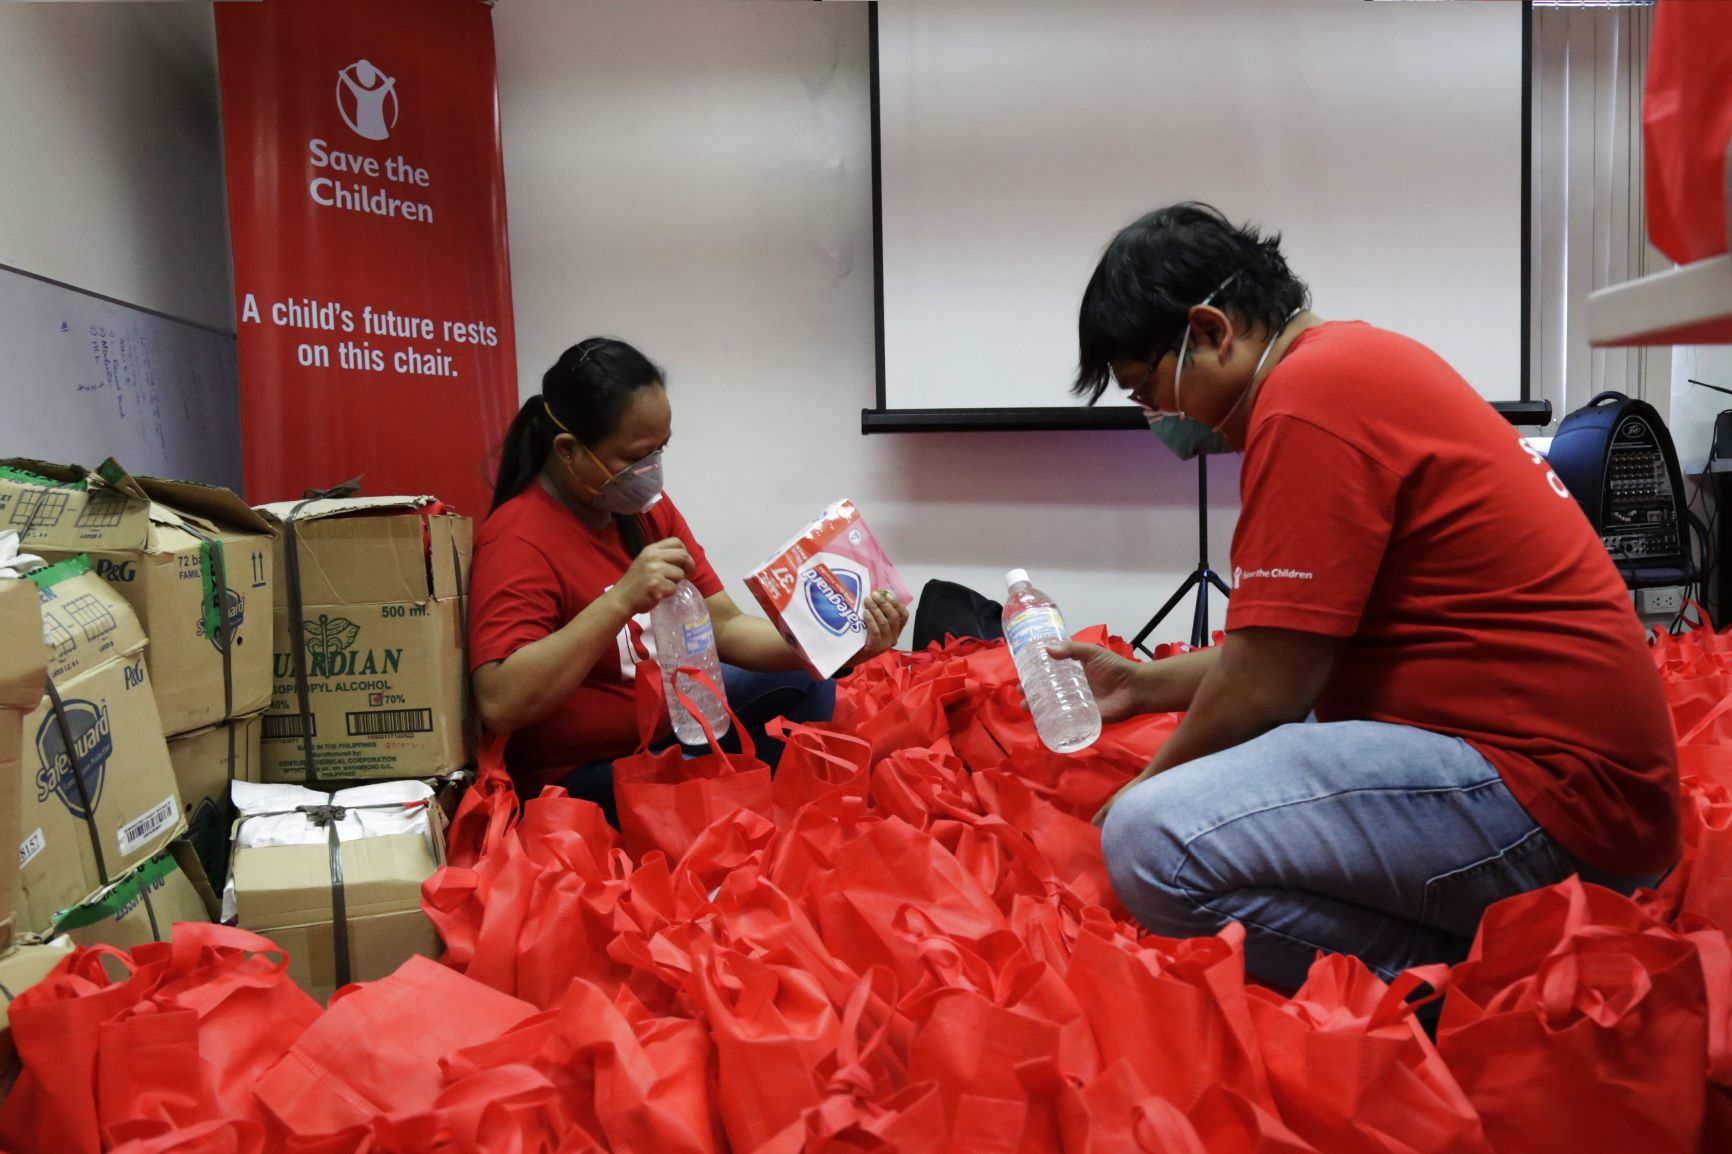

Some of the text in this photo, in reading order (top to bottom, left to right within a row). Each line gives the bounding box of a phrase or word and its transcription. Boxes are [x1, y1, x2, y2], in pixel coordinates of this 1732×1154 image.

[309, 138, 430, 187] Save the
[309, 177, 434, 223] Children
[242, 293, 498, 347] A child's future rests
[297, 341, 459, 377] on this chair.
[96, 558, 136, 582] P&G
[178, 555, 190, 569] 72
[1256, 568, 1270, 578] the
[1270, 567, 1313, 580] Children
[179, 569, 203, 580] FAMIL
[382, 605, 405, 618] 500
[800, 567, 867, 634] Safeguard
[123, 658, 144, 690] P&G
[273, 648, 403, 678] URDIAN
[335, 679, 391, 692] ALCOHOL
[384, 694, 405, 705] 70%
[348, 755, 397, 764] CORPORATION
